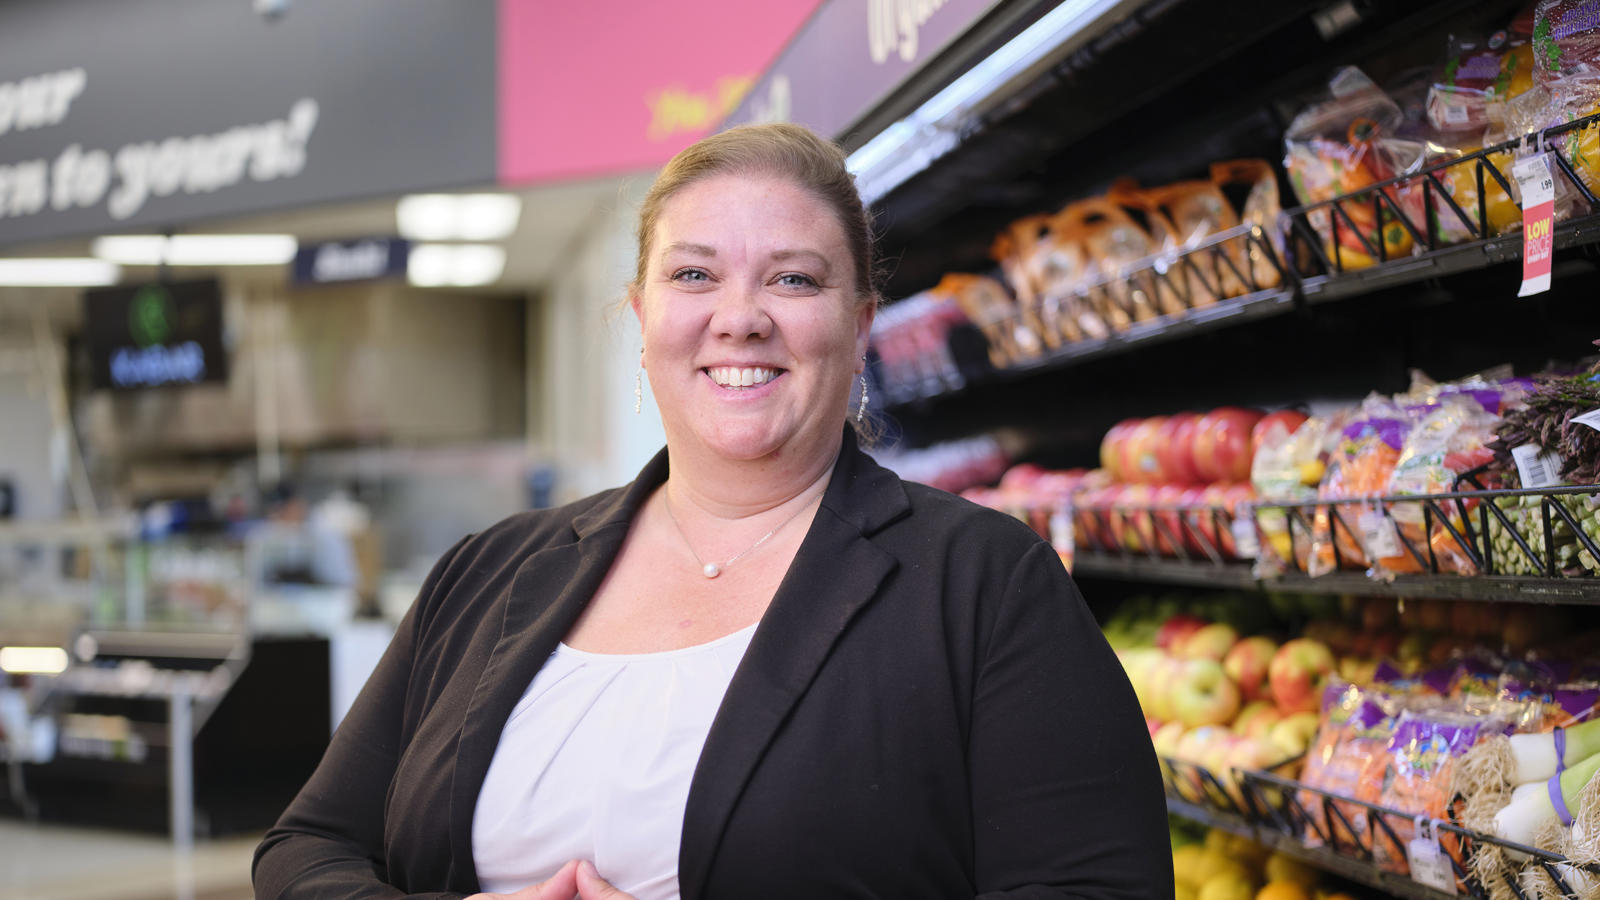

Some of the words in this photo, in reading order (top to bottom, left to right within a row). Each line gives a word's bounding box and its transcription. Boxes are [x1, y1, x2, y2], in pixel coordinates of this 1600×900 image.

[1561, 0, 1600, 24] ORGANI
[50, 142, 111, 212] to
[107, 97, 319, 220] yours!
[1527, 217, 1550, 241] LOW
[1527, 234, 1550, 257] PRICE
